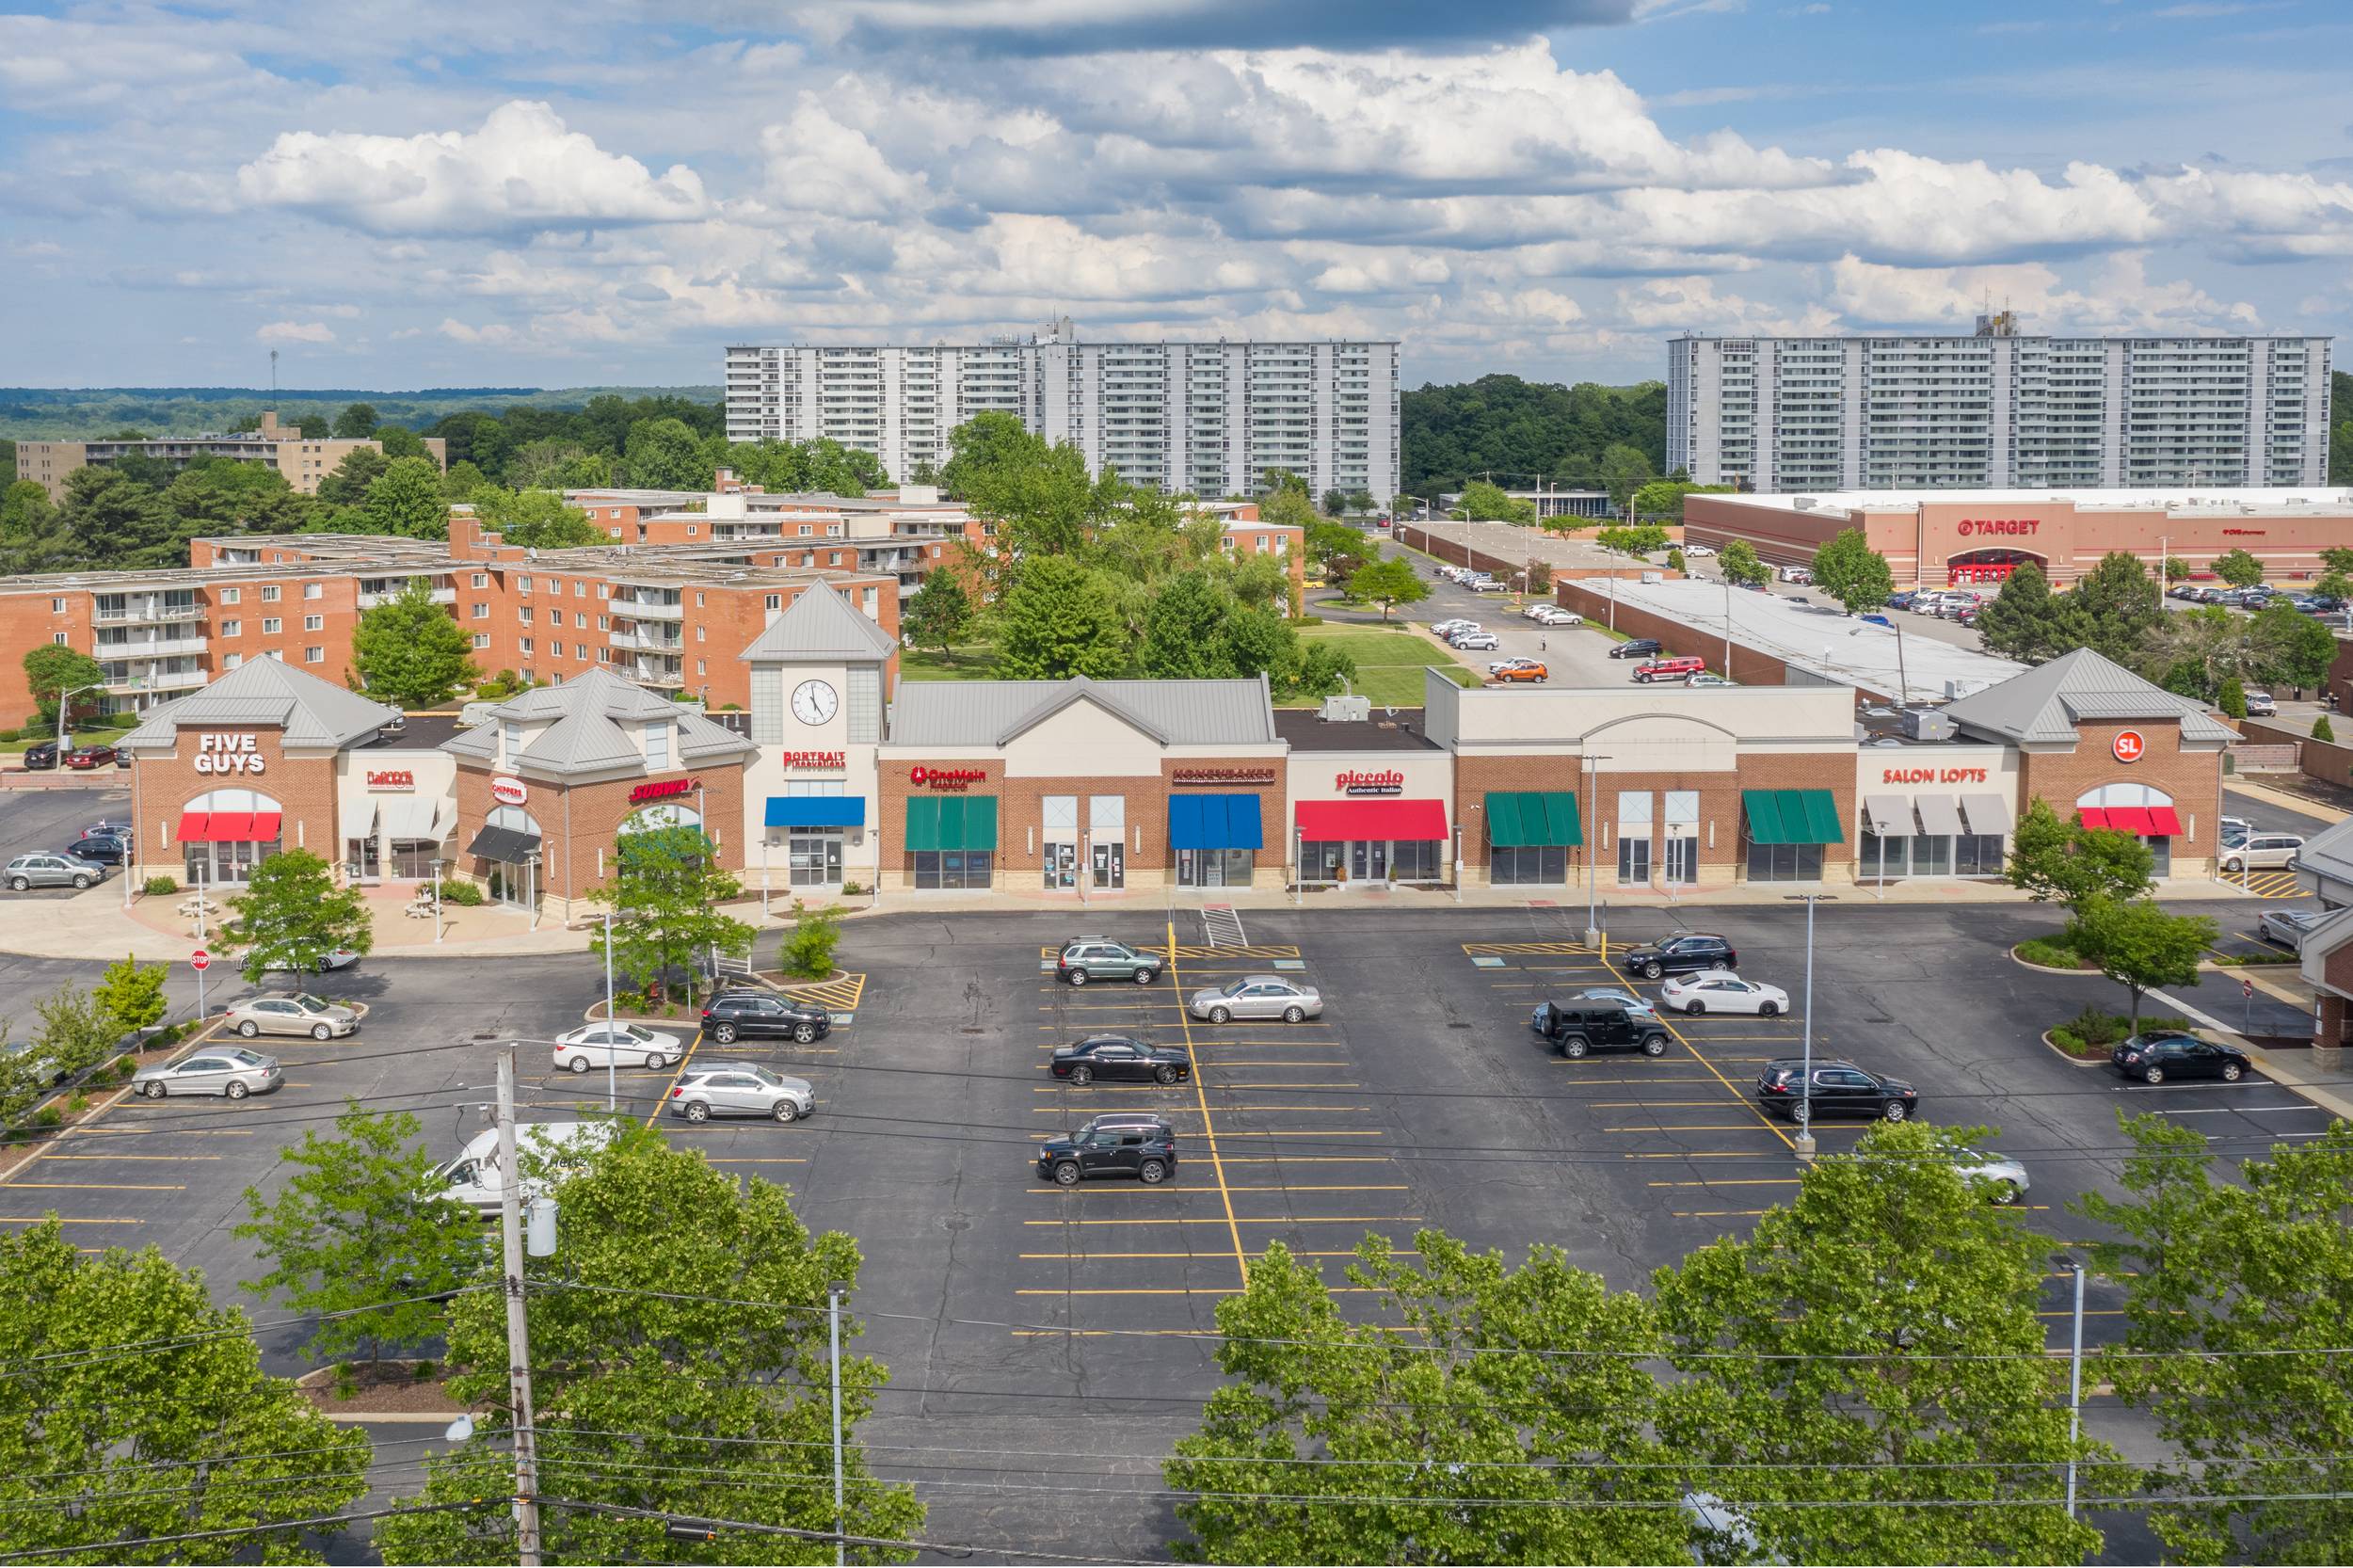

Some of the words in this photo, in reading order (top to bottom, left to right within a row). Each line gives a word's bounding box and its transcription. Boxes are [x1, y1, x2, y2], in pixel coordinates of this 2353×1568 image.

[1975, 520, 2041, 535] TARGET
[200, 734, 257, 752] FIVE
[2119, 738, 2139, 753] SL
[194, 754, 264, 773] GUYS
[783, 751, 846, 767] PORTRAIT
[929, 768, 986, 781] OneMain
[1335, 769, 1404, 789] piccolo
[1882, 768, 1935, 784] SALON
[1940, 768, 1988, 784] LOFTS
[628, 776, 702, 802] SUBWAY
[192, 955, 208, 964] STOP
